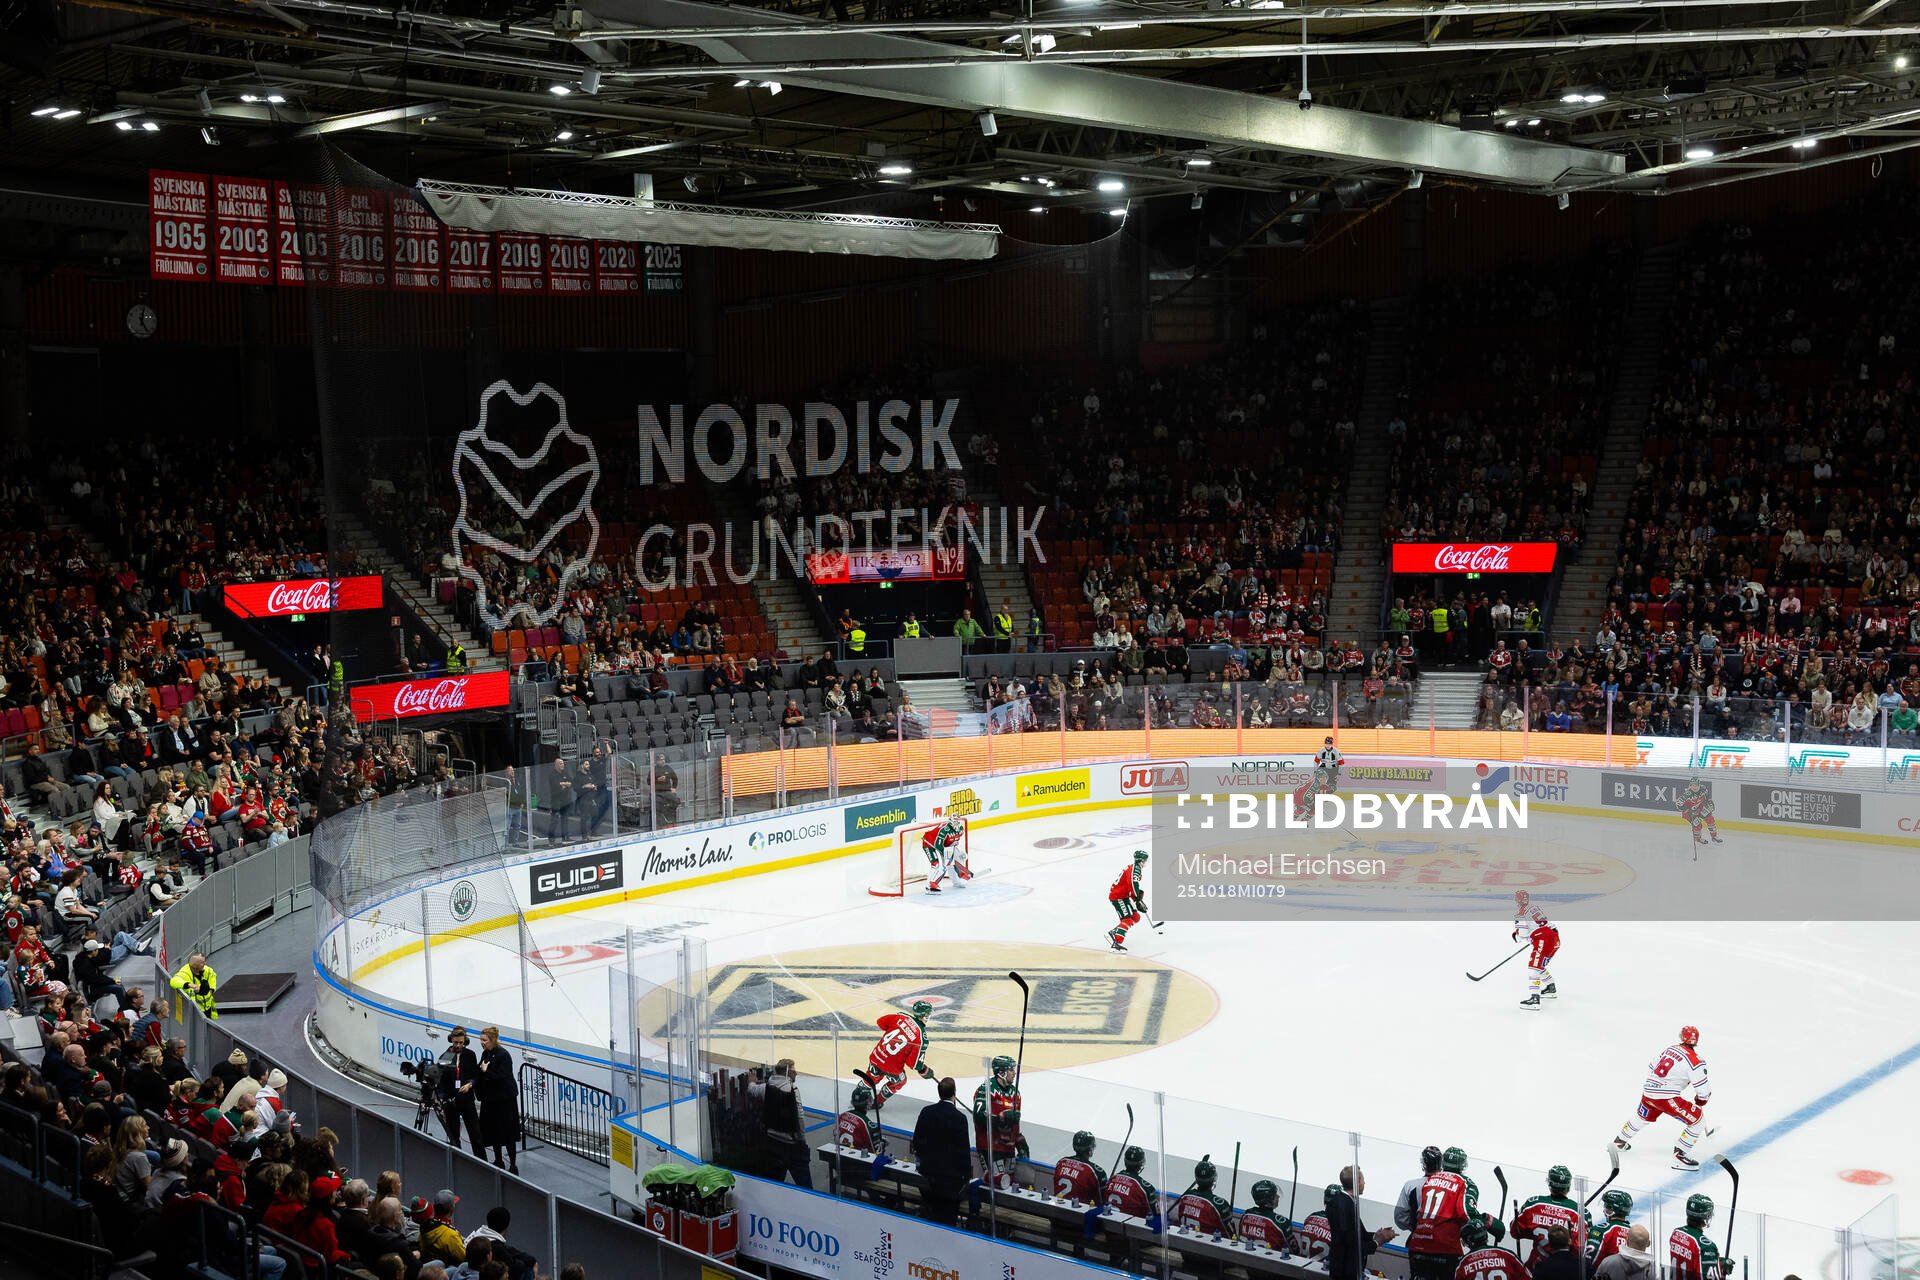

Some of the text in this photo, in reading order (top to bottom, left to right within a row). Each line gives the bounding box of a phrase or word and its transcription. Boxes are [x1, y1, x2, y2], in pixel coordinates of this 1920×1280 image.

[153, 177, 206, 197] SVENSKA
[217, 183, 268, 202] SVENSKA
[153, 194, 207, 214] MÄSTARE
[217, 198, 268, 218] MÄSTARE
[155, 220, 207, 252] 1965
[219, 226, 269, 254] 2003
[280, 230, 328, 257] 2005
[340, 235, 384, 262] 2016
[395, 237, 439, 265] 2016
[450, 241, 491, 266] 2017
[501, 243, 542, 268] 2019
[550, 244, 590, 270] 2019
[600, 246, 636, 269] 2020
[645, 245, 682, 269] 2025
[155, 258, 194, 276] FRÖLUNDA
[220, 262, 257, 279] FRÖLUNDA
[637, 398, 962, 486] NORDISK
[634, 505, 1048, 593] GRUNDTEKNIK
[1434, 545, 1513, 570] Coca-Cola
[267, 577, 342, 613] Coca-Cola
[393, 678, 470, 715] Coca-Cola
[1124, 766, 1187, 789] JULA
[1231, 760, 1295, 773] NORDIC
[1349, 767, 1433, 782] SPORTBLADET
[1514, 766, 1569, 785] INTER
[1033, 780, 1086, 797] Ramudden
[1216, 772, 1311, 787] WELLNESS
[949, 788, 974, 805] EURO
[1513, 783, 1569, 802] SPORT
[1771, 790, 1802, 806] ONE
[1803, 792, 1837, 805] RETAIL
[856, 808, 907, 831] Assemblin
[1758, 803, 1802, 820] MORE
[1803, 802, 1836, 814] EVENT
[1803, 811, 1830, 823] EXPO
[768, 823, 827, 847] PROLOGIS
[641, 845, 697, 881] Morris
[537, 861, 616, 893] GUIDE
[566, 888, 580, 896] RIGHT
[581, 884, 601, 893] GLOVES
[1063, 977, 1118, 1017] BYGG
[381, 1036, 396, 1055] JO
[397, 1042, 434, 1067] FOOD
[882, 1028, 909, 1056] 43
[559, 1082, 577, 1103] JO
[581, 1083, 627, 1114] FOOD
[1060, 1167, 1080, 1179] FOLIN
[1057, 1178, 1074, 1198] 2
[1422, 1188, 1446, 1220] 11
[750, 1213, 840, 1257] JO FOOD
[772, 1247, 801, 1261] IMPORT
[853, 1250, 895, 1270] SEAFOOD
[881, 1228, 889, 1276] NORWAY
[1463, 1258, 1506, 1275] PETERSON
